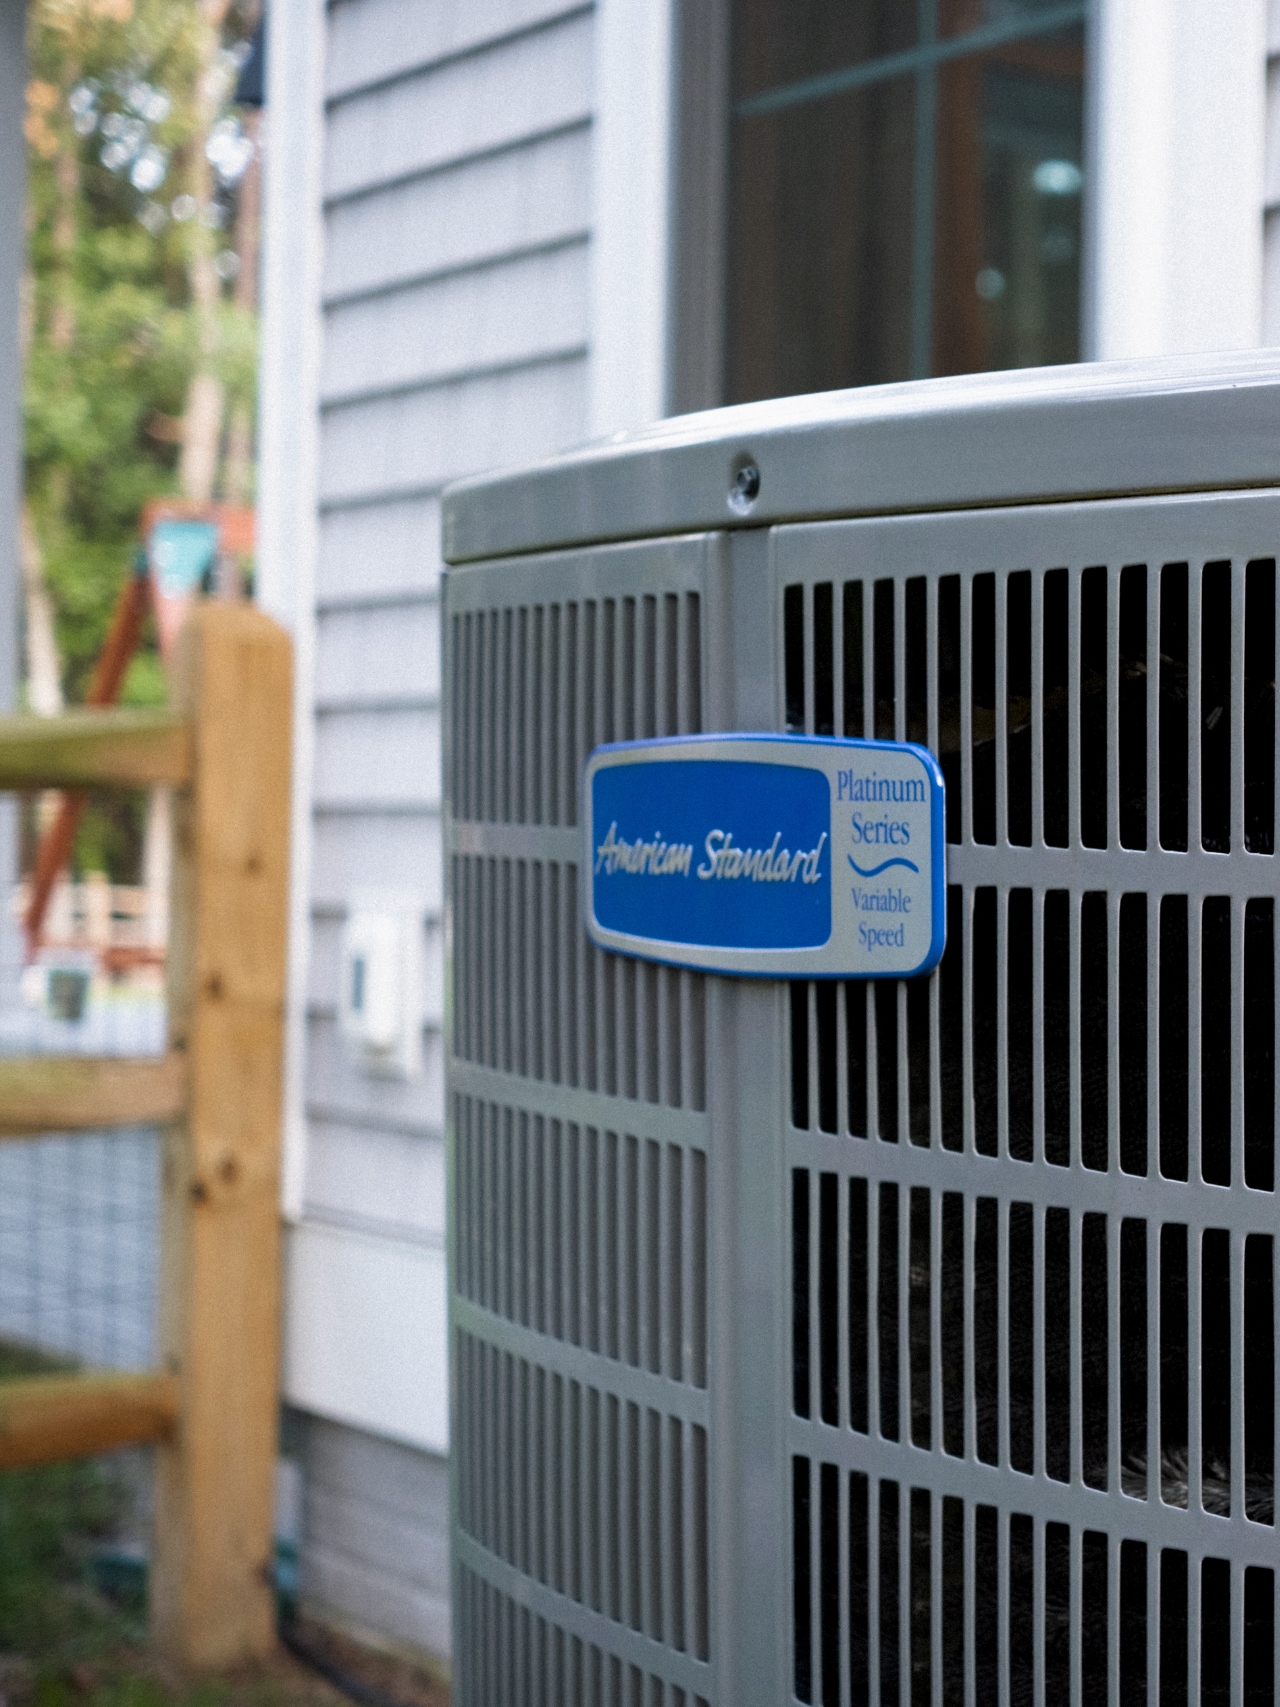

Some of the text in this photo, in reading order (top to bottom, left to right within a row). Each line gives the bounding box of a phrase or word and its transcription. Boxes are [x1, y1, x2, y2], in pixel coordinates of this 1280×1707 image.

[837, 769, 926, 802] Platinum
[851, 813, 910, 845] Series
[594, 820, 828, 884] American Standard
[851, 887, 912, 913] Variable
[858, 921, 904, 952] Speed
